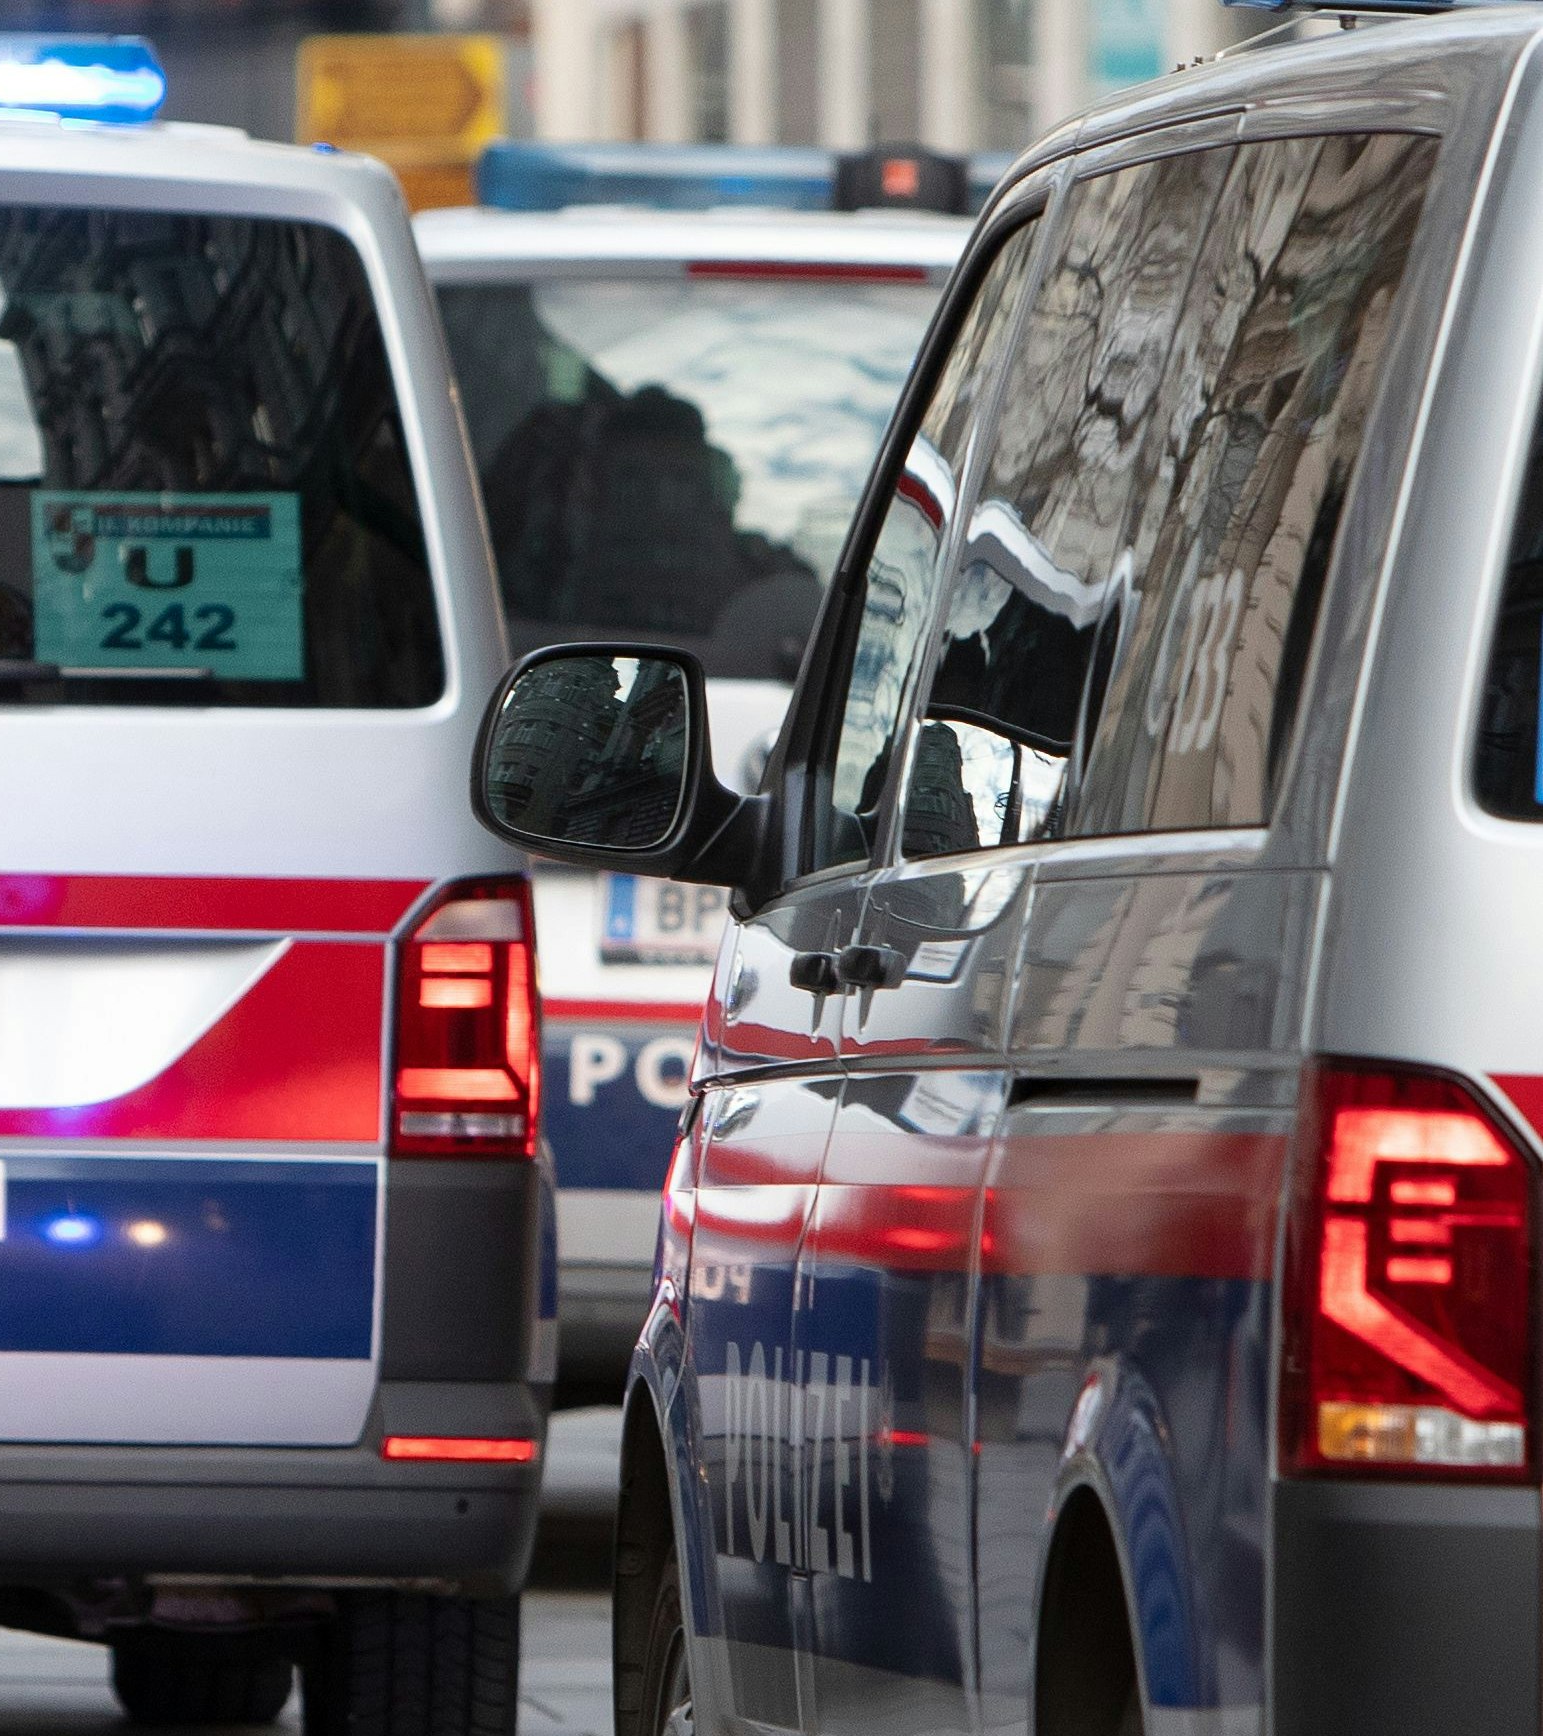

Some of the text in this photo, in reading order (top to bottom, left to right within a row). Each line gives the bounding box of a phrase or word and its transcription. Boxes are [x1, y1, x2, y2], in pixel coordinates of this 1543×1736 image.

[126, 514, 256, 533] KOMPANIE
[125, 546, 194, 589] U
[99, 602, 237, 651] 242
[657, 885, 722, 933] BP
[725, 1341, 873, 1584] POLIZEI
